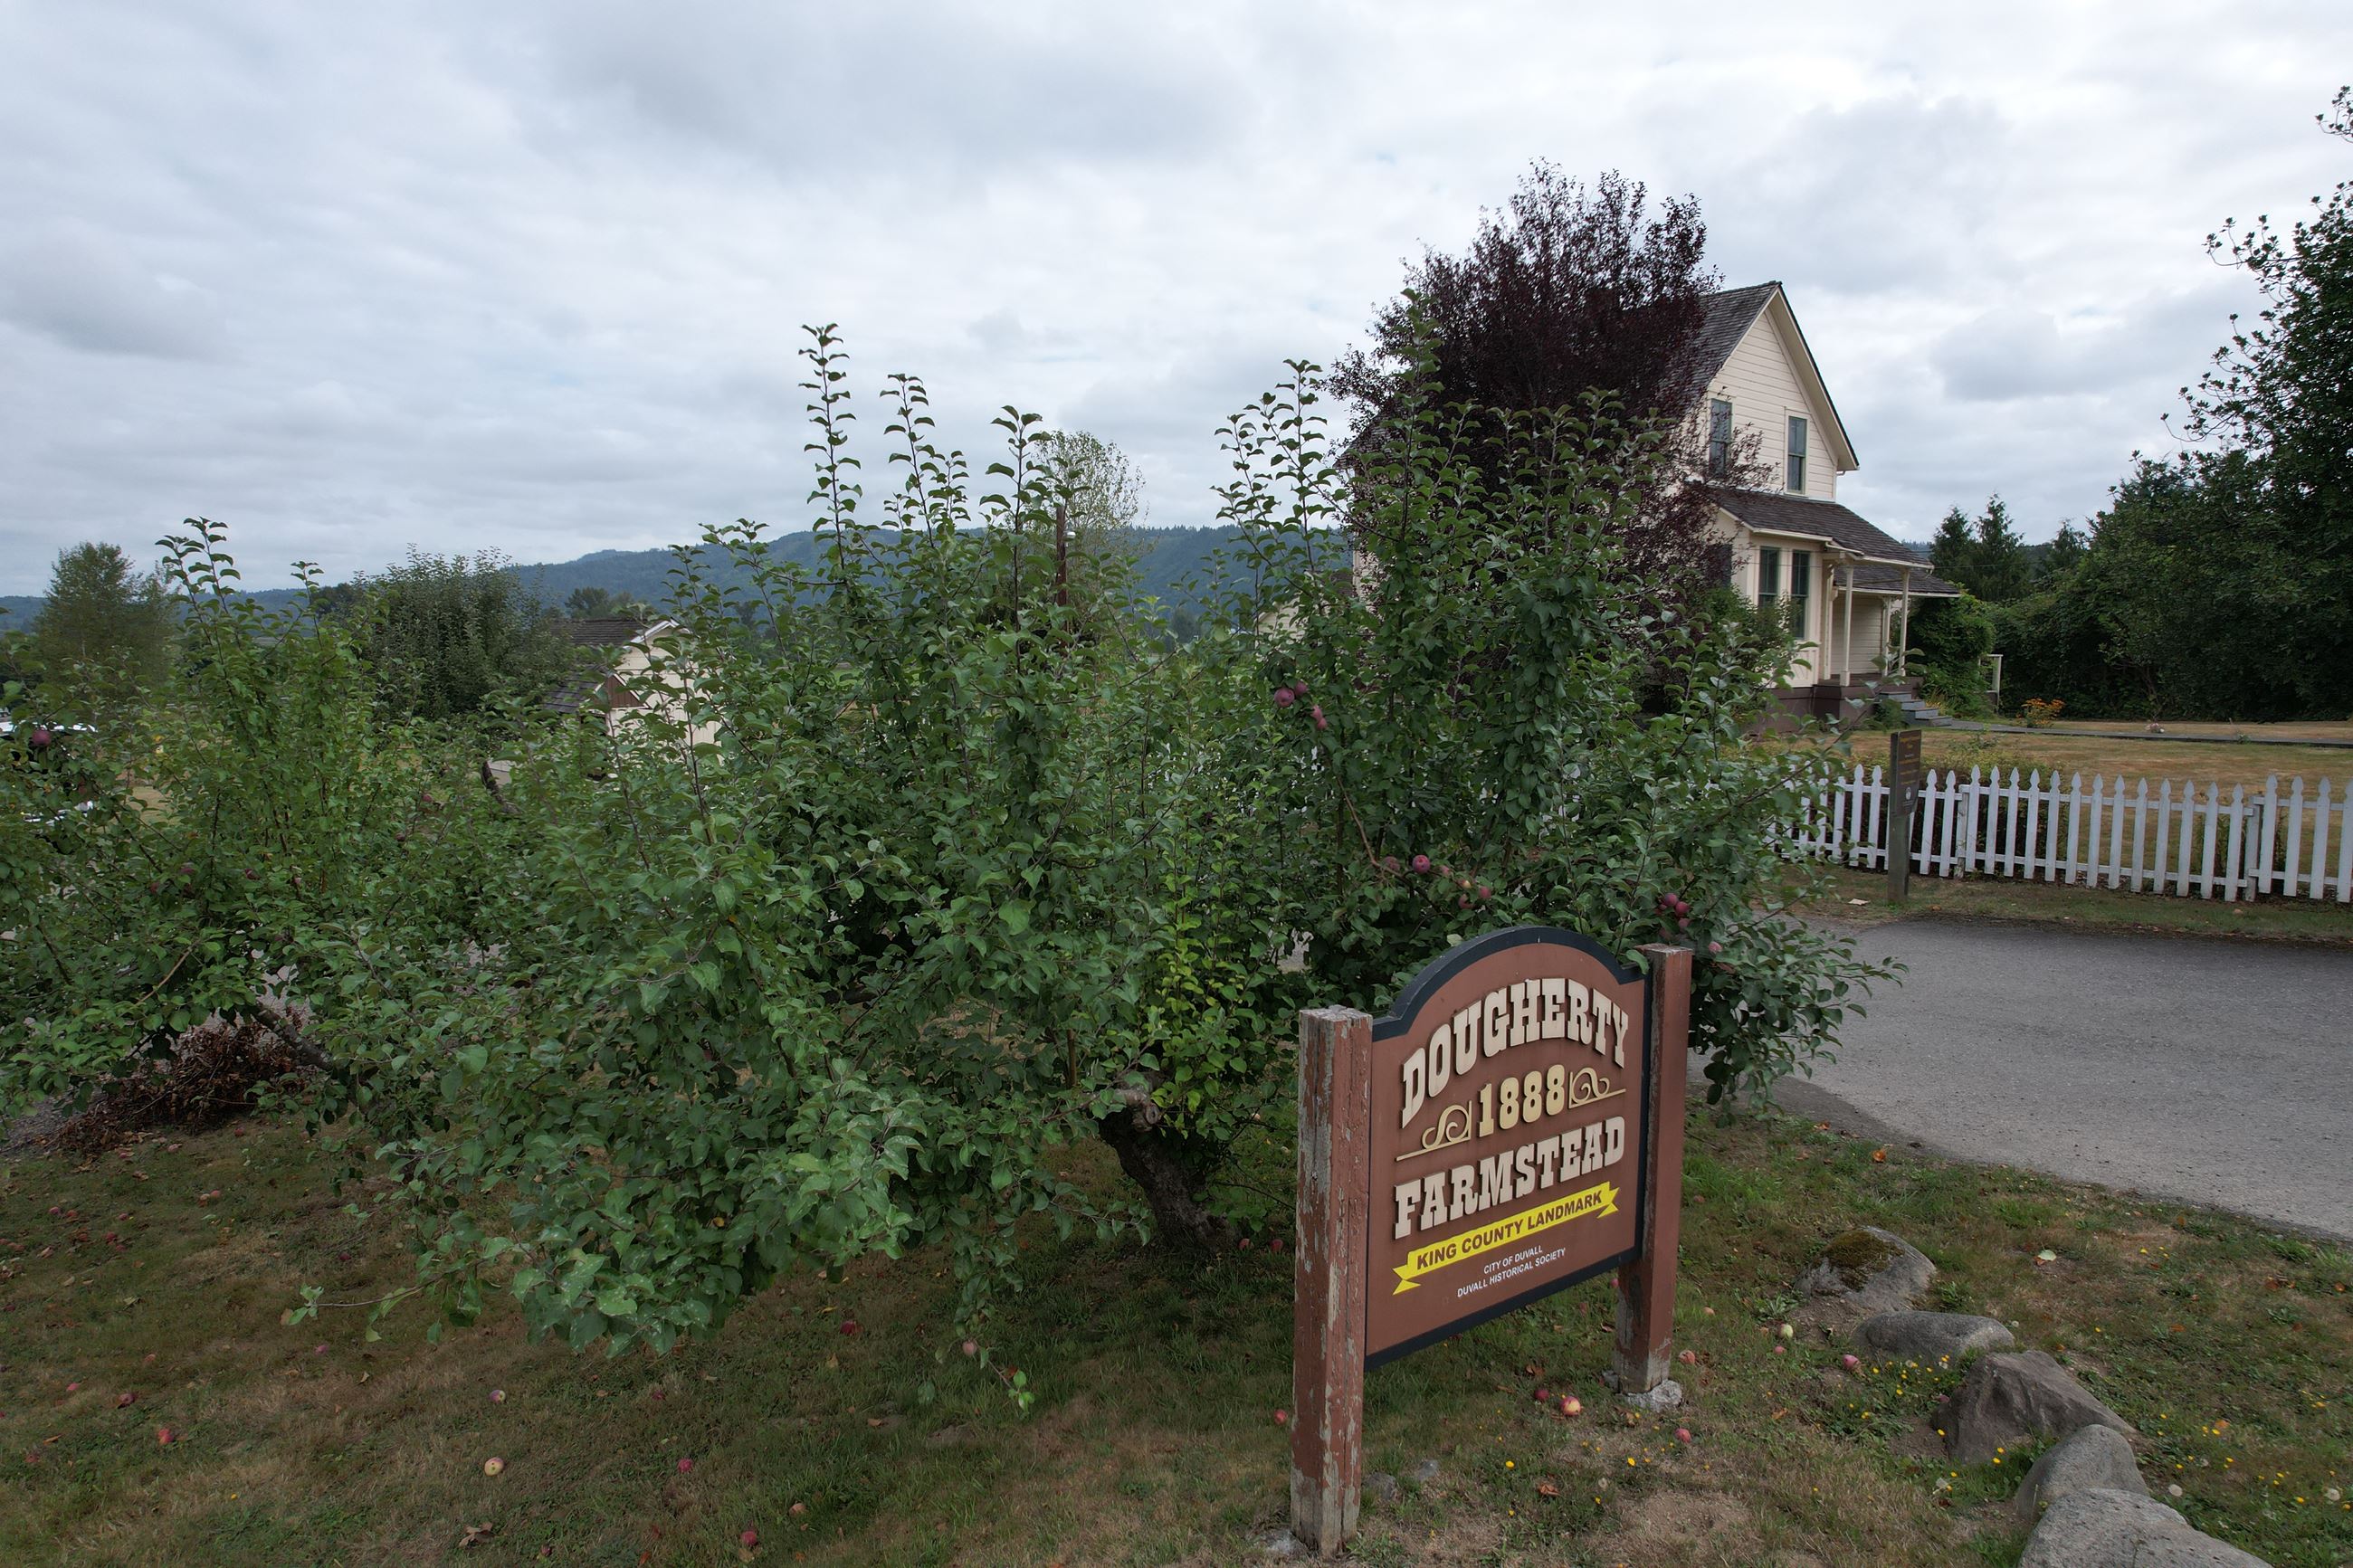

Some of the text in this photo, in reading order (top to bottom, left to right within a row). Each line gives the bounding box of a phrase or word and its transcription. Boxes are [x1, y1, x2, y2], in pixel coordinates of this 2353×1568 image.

[1400, 978, 1629, 1129] DOUGHERTY
[1478, 1064, 1566, 1138] 1888
[1394, 1116, 1625, 1240] FARMSTEAD
[1416, 1191, 1602, 1269] KING COUNTY LANDMARK
[1483, 1245, 1543, 1275] CITY OF DUVALL
[1457, 1248, 1566, 1297] DUVALL HISTORICAL SOCIETY
